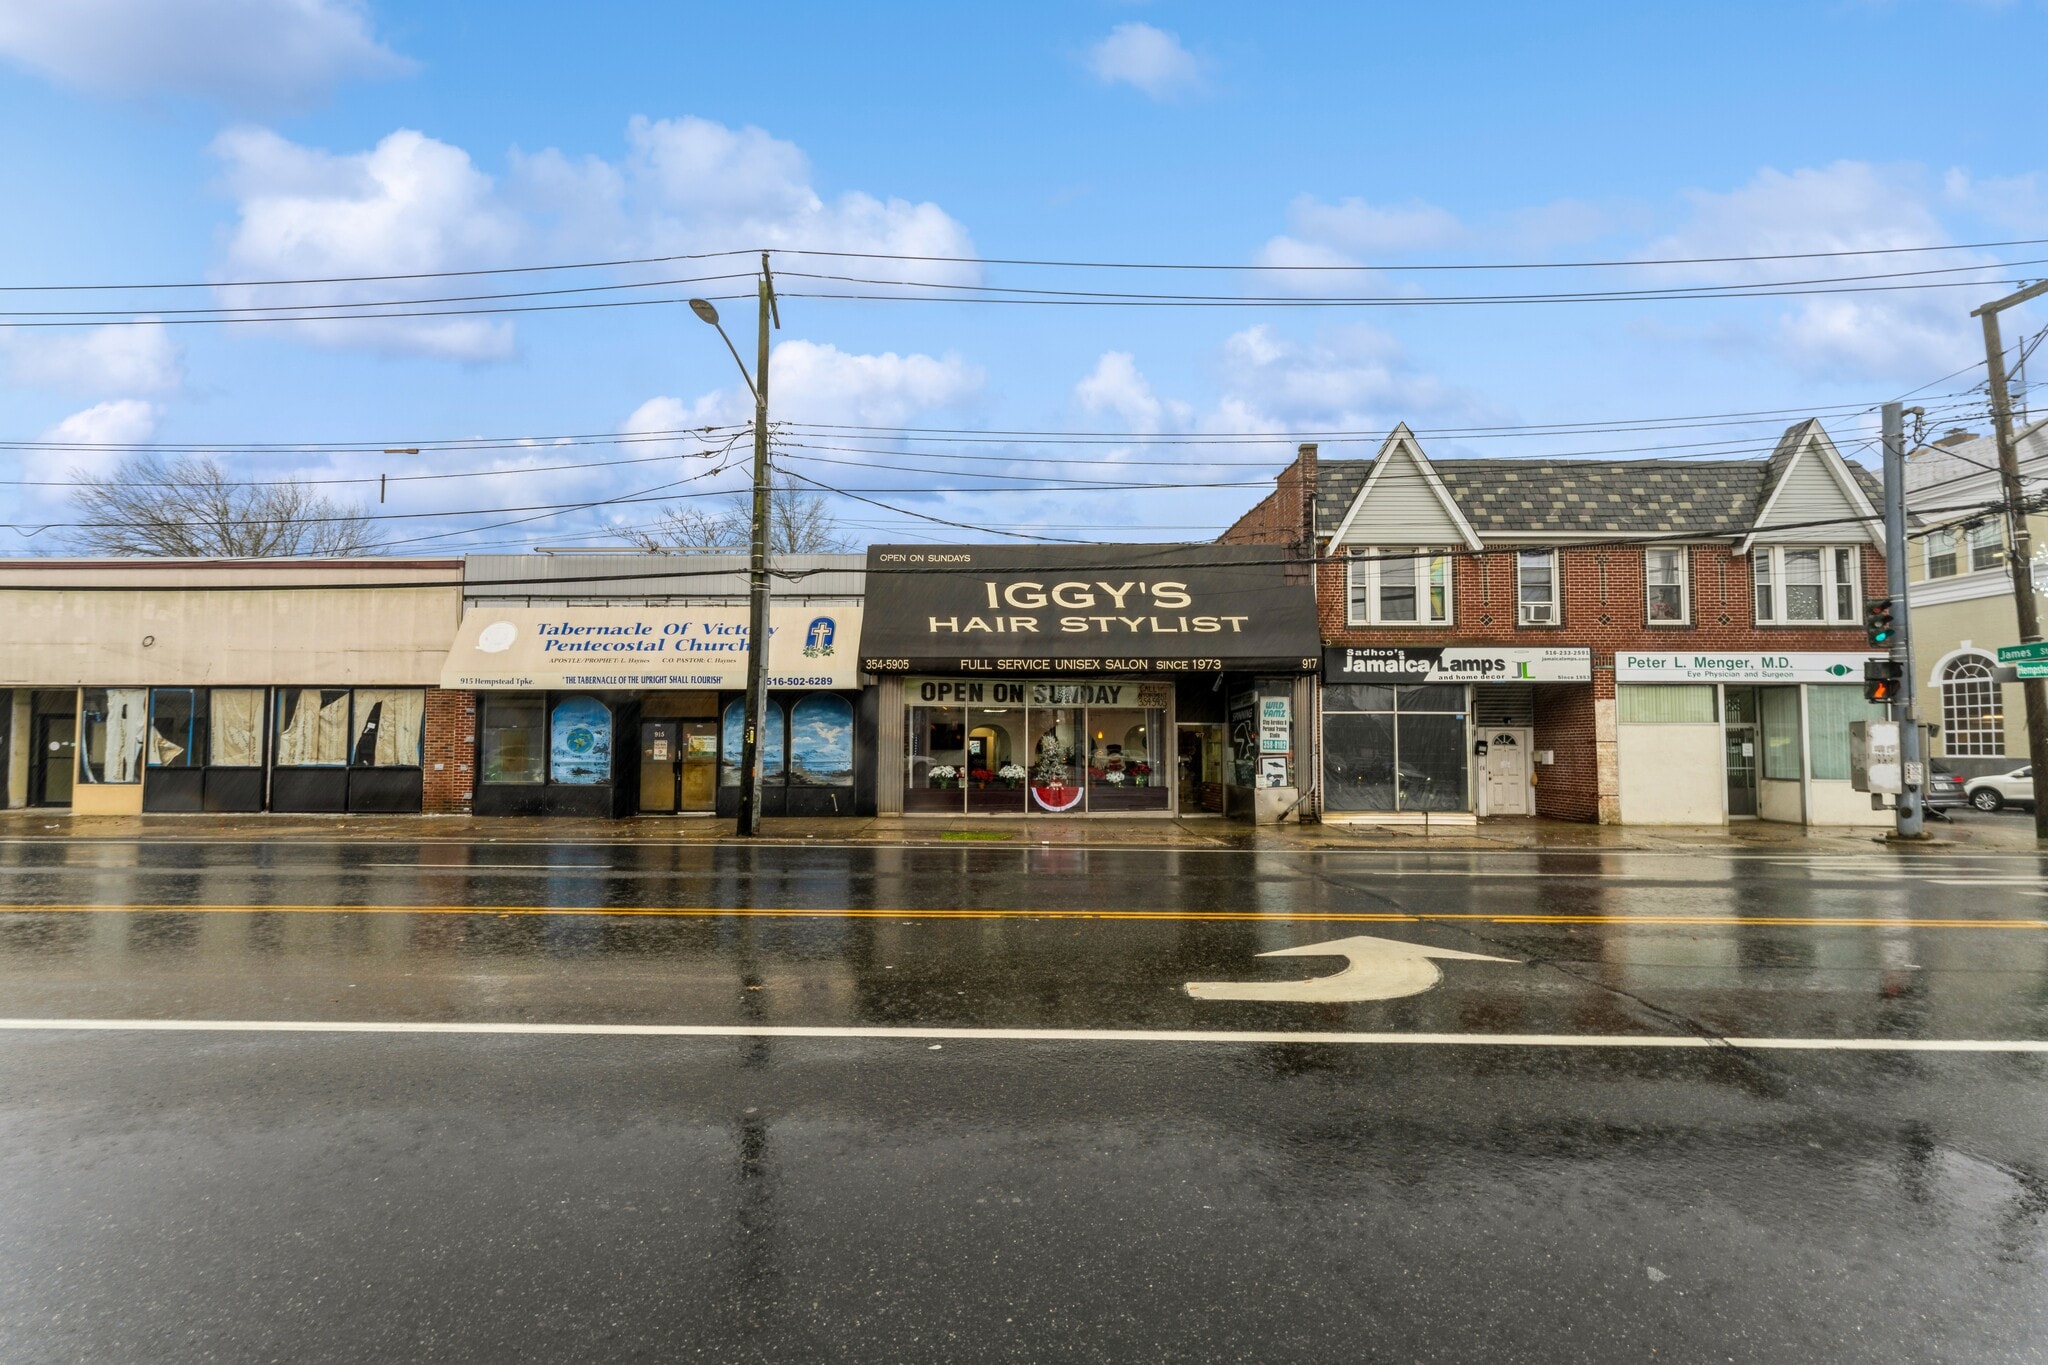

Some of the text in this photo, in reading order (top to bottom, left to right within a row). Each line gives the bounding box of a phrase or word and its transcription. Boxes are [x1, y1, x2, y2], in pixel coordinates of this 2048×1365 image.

[880, 554, 906, 562] OPEN
[985, 581, 1192, 609] IGGY'S
[538, 622, 779, 638] Tabernacle Of Victoy
[929, 616, 1249, 633] HAIR STYLIST
[545, 638, 751, 652] Pentecostal Church
[1346, 648, 1405, 656] Sadhoo's
[2000, 649, 2032, 660] James
[865, 659, 910, 670] 354-5905
[960, 659, 1222, 670] FULL SERVICE UNISEX SALON SINCE 1973
[1302, 658, 1317, 669] 917
[1343, 655, 1506, 675] Jamaica Lamps
[1628, 656, 1793, 670] Peter L. Menger, M.D.
[460, 677, 535, 687] 915 Hempstead Tpke.
[578, 676, 617, 684] TABERNACLE
[618, 676, 627, 684] OF
[628, 676, 639, 684] THE
[641, 676, 667, 684] UPRIGHT
[669, 676, 688, 684] SHALL
[766, 677, 833, 686] 516-502-6289
[921, 682, 1122, 704] OPEN ON SUNDAY
[1265, 702, 1284, 710] WILD
[1263, 710, 1286, 718] YAMZ
